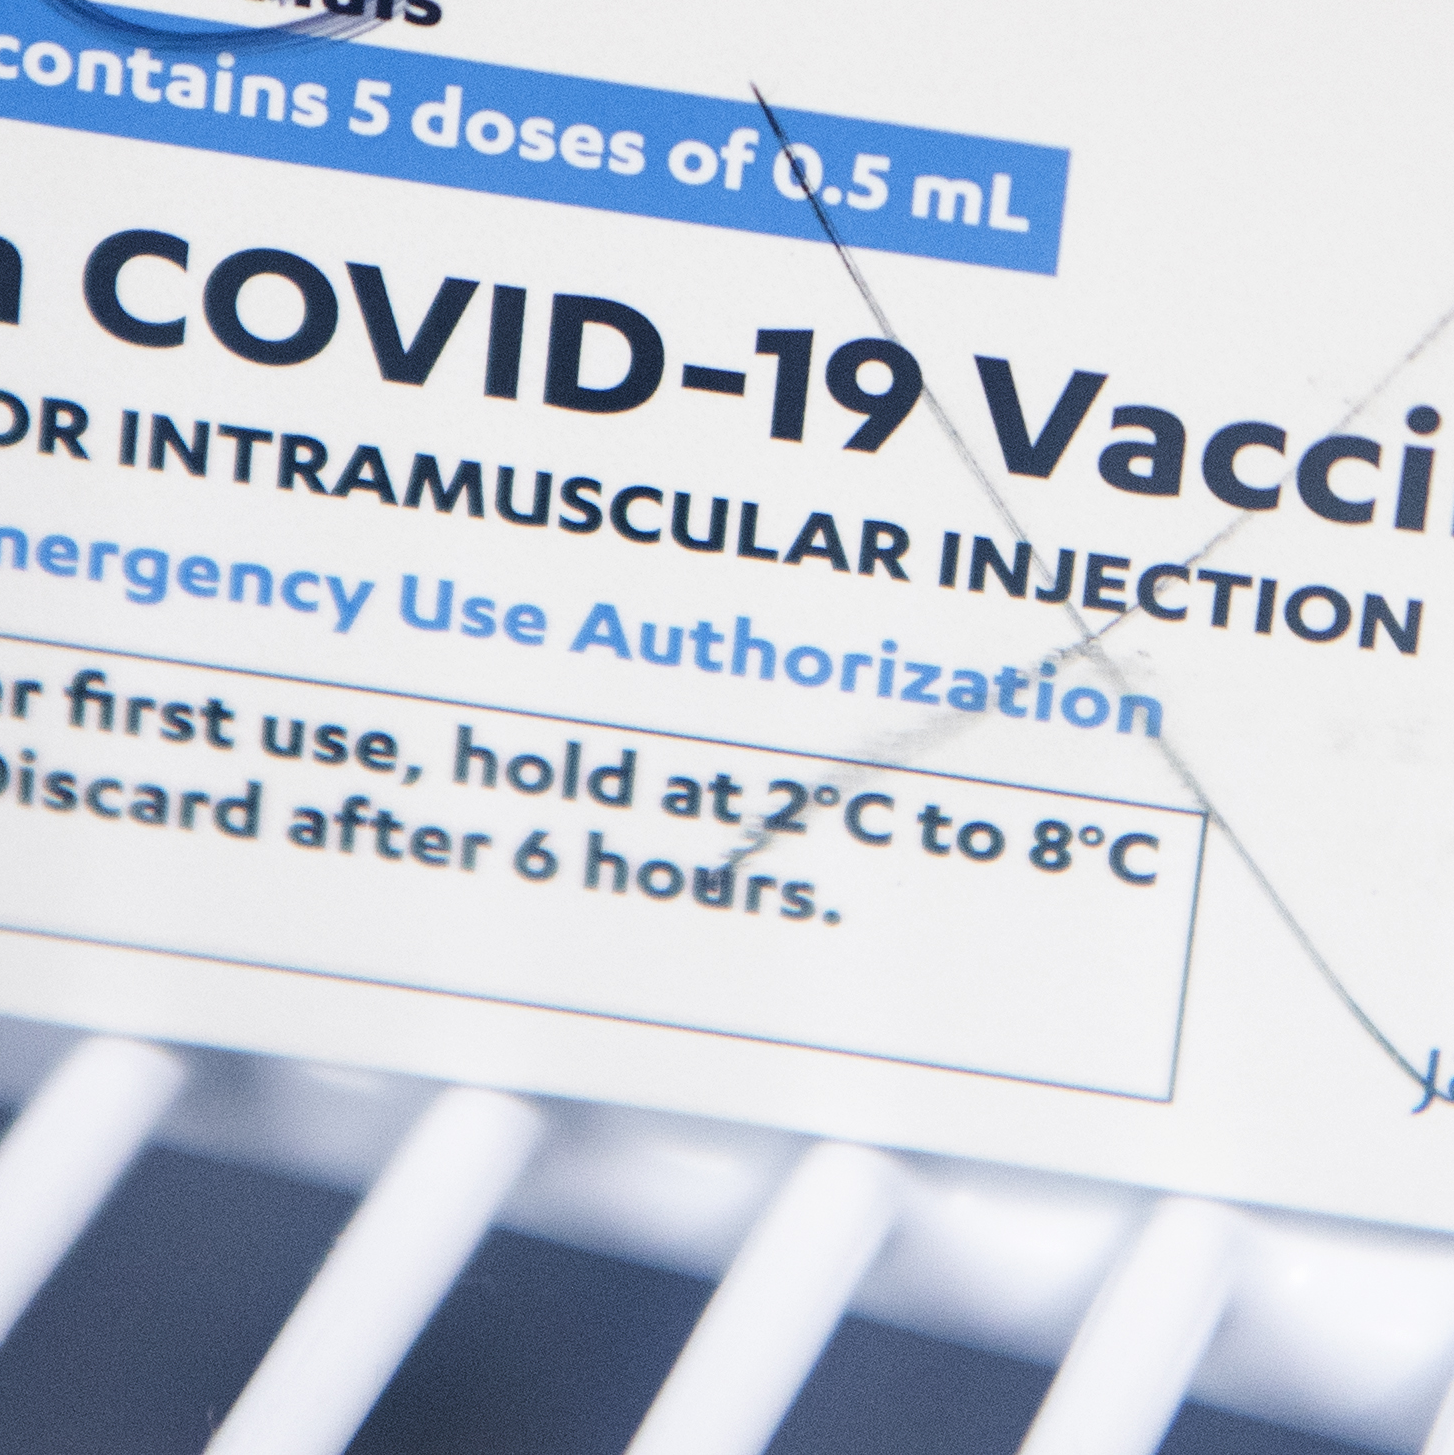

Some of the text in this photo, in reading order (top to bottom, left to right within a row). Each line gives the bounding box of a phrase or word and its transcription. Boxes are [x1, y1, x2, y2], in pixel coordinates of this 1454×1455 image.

[346, 78, 393, 137] 5
[409, 85, 646, 176] doses
[667, 127, 761, 191] of
[770, 141, 892, 212] 0.5
[911, 172, 1031, 235] mL
[81, 227, 926, 454] COVID-19
[117, 409, 912, 583] INTRAMUSCULAR
[939, 530, 1425, 657] INJECTION
[400, 575, 550, 650] Use
[570, 600, 1167, 741] Authorization
[62, 669, 236, 751] first
[260, 713, 424, 787] use,
[452, 723, 635, 823] hold
[661, 767, 747, 829] at
[763, 778, 895, 850] 2°C
[917, 805, 1007, 866] to
[1027, 819, 1161, 890] 8°C
[286, 794, 493, 879] after
[512, 829, 561, 885] 6
[583, 832, 845, 928] hours.
